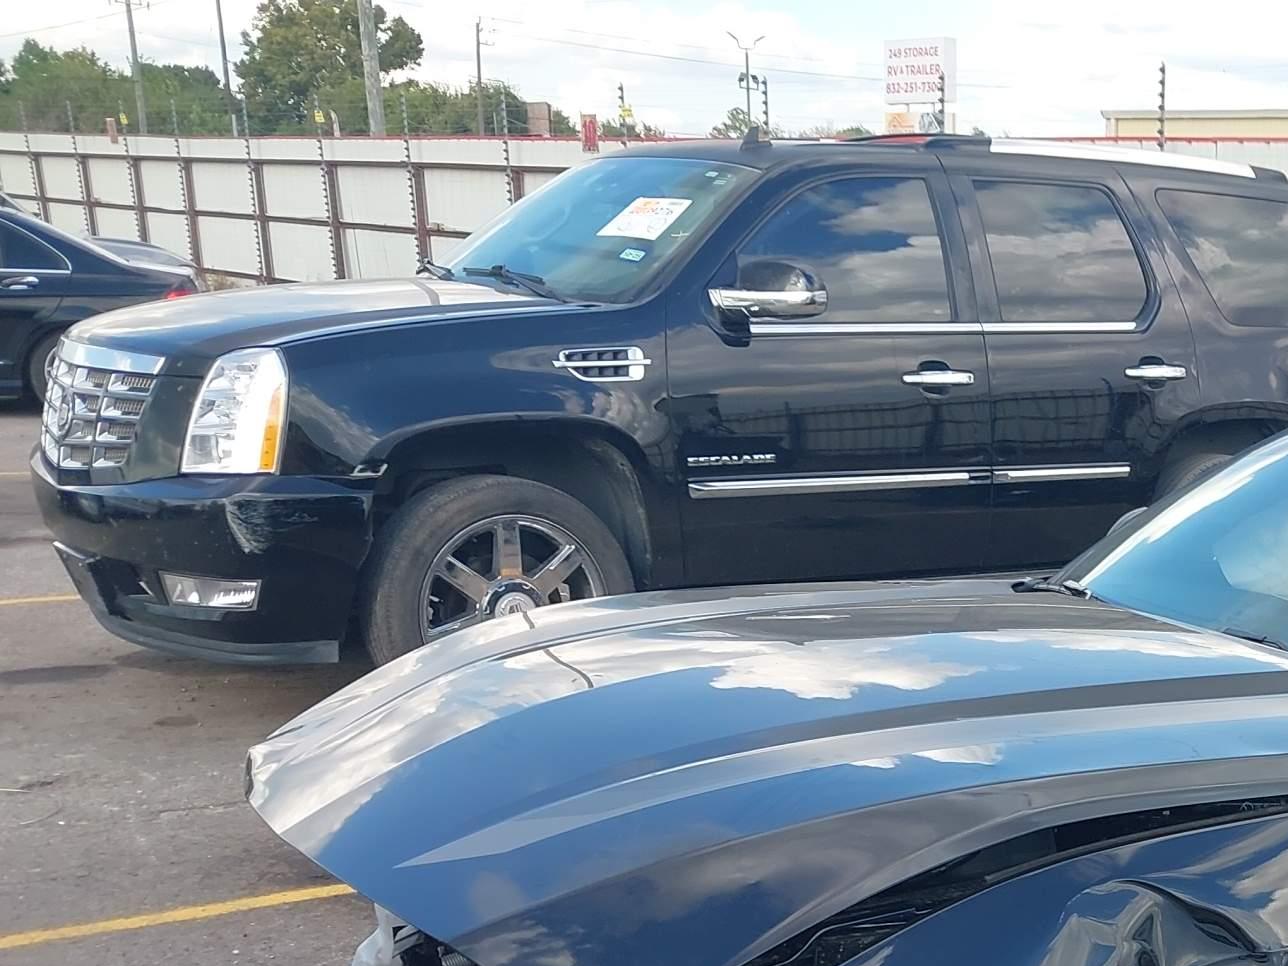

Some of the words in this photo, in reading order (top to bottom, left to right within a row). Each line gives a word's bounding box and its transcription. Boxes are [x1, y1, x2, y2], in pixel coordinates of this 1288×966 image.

[888, 48, 902, 59] 249
[904, 46, 939, 58] STORAGE
[887, 65, 899, 77] RV
[905, 63, 942, 76] TRAILER
